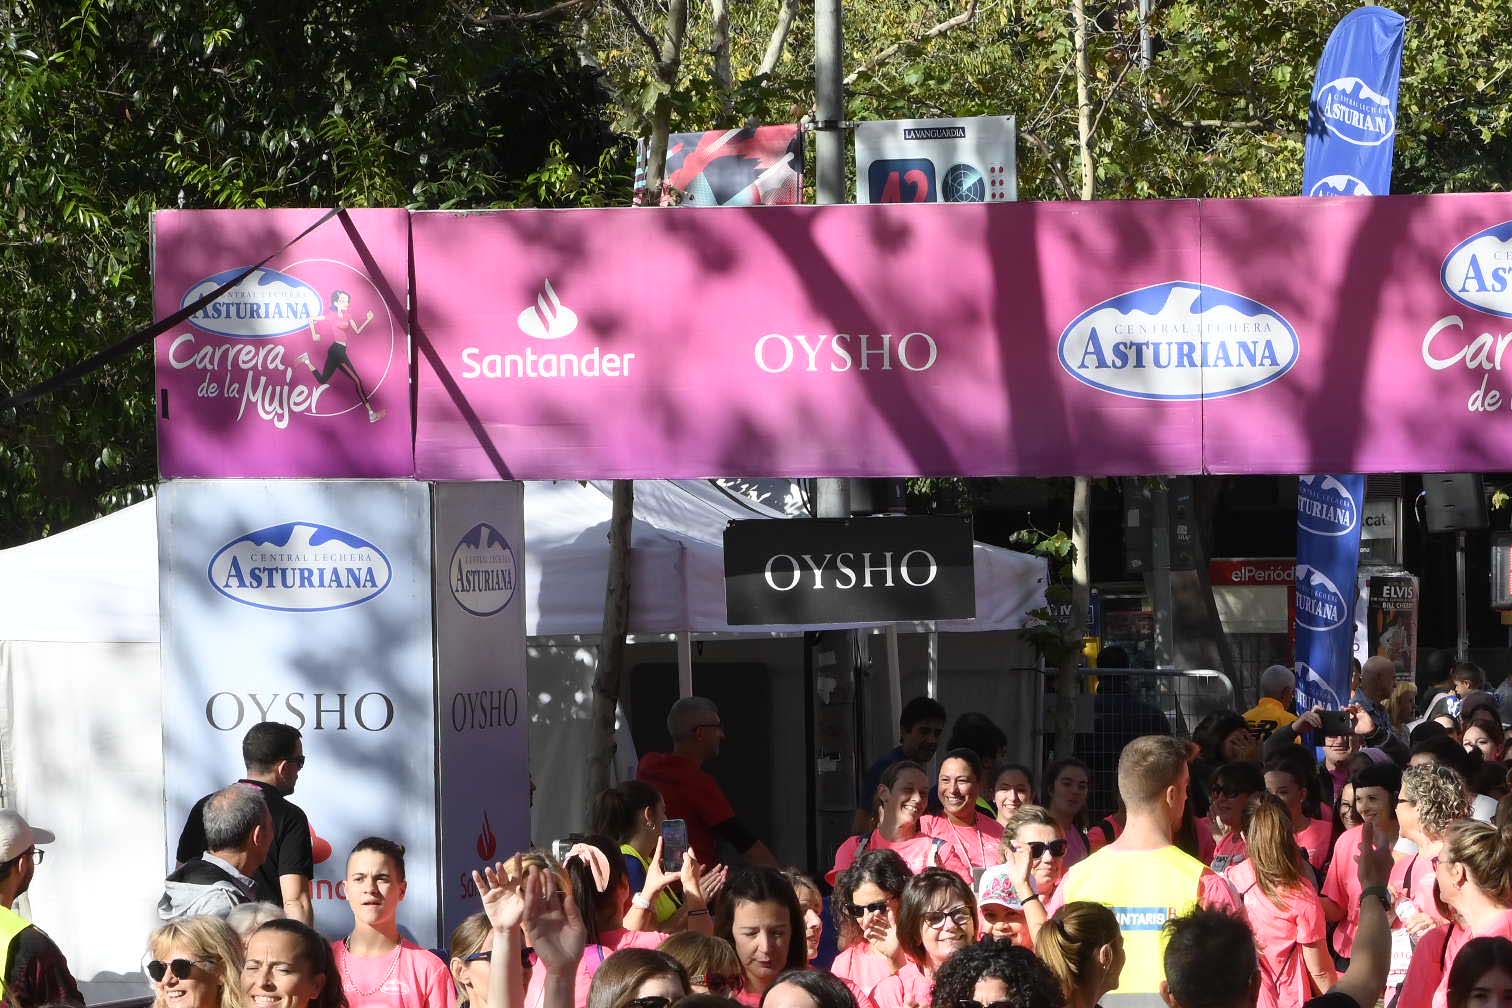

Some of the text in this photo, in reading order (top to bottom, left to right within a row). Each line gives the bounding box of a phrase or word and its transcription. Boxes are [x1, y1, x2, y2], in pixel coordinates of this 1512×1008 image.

[1113, 322, 1188, 336] CENTRAL
[168, 333, 286, 371] Carrera
[462, 347, 635, 379] Santander
[754, 332, 938, 374] OYSHO
[1076, 326, 1280, 371] ASTURIANA
[197, 367, 330, 430] de la Mujer
[1466, 373, 1503, 412] de
[1298, 496, 1351, 528] TURIANA
[222, 555, 379, 590] ASTURIANA
[250, 551, 310, 563] CENTRAL
[764, 549, 938, 592] OYSHO
[454, 566, 513, 593] ASTURIANA
[1382, 585, 1414, 599] ELVIS
[205, 691, 394, 732] OYSHO
[451, 688, 518, 733] OYSHO
